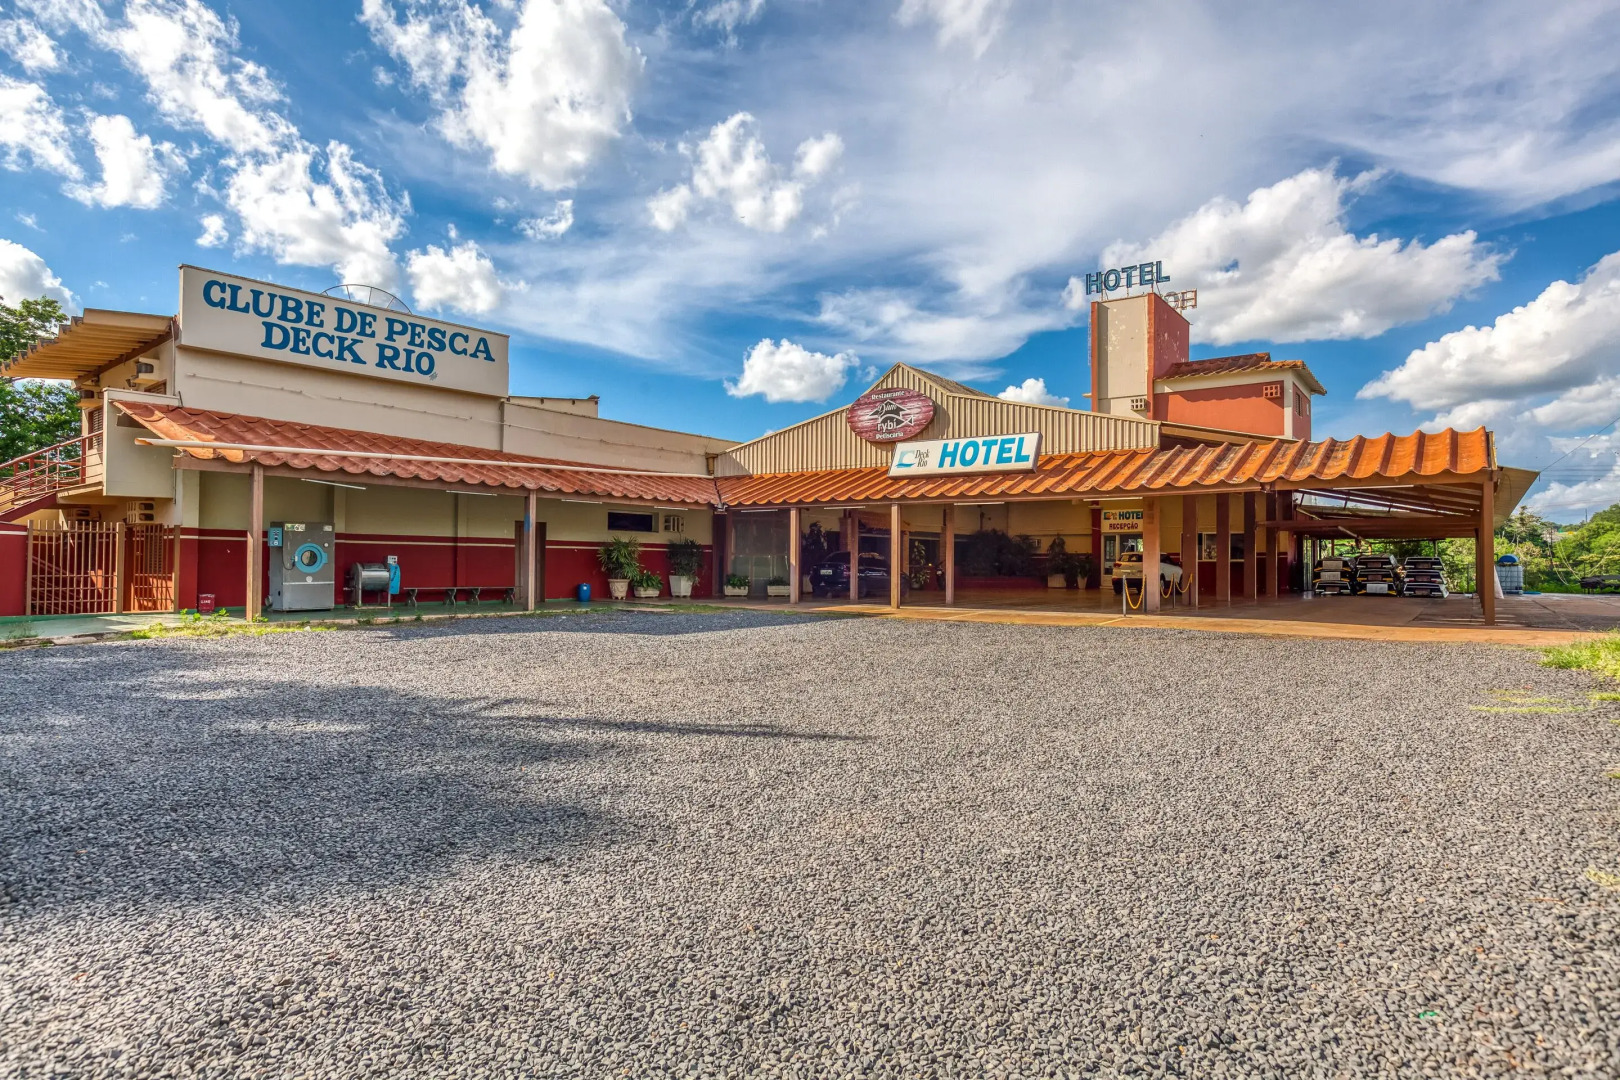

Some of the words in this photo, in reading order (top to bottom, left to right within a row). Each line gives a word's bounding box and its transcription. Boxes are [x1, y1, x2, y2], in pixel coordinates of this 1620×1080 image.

[1086, 260, 1170, 295] HOTEL
[203, 280, 325, 328] CLUBE
[334, 307, 377, 338] DE
[384, 317, 495, 362] PESCA
[261, 321, 367, 365] DECK
[375, 343, 435, 376] RIO
[871, 390, 905, 400] Restaurante
[876, 431, 904, 440] Petiscaria
[915, 449, 930, 460] Deck
[917, 458, 928, 467] Rio
[938, 437, 1030, 468] HOTEL
